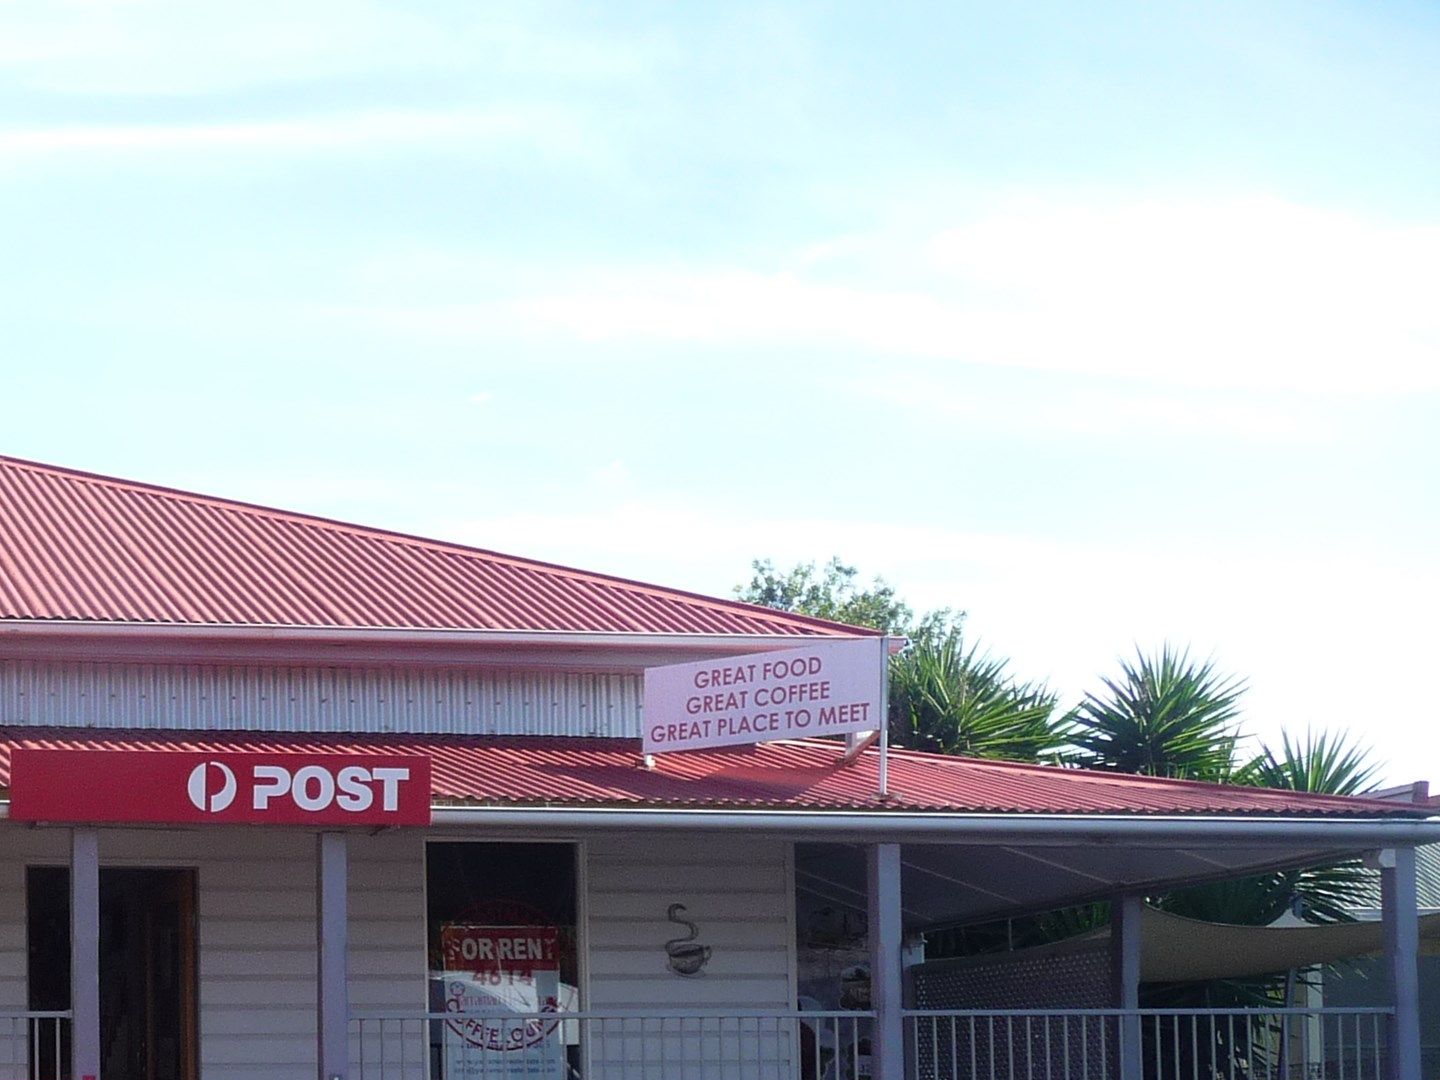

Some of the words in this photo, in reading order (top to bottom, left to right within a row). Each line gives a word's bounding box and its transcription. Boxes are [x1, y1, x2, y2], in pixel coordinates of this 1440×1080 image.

[694, 664, 756, 689] GREAT
[763, 656, 822, 681] FOOD
[686, 691, 748, 715] GREAT
[754, 681, 830, 707] COFFEE
[651, 720, 711, 743] GREAT
[717, 712, 779, 737] PLACE
[785, 709, 811, 729] TO
[818, 702, 870, 726] MEET
[253, 765, 410, 811] POST
